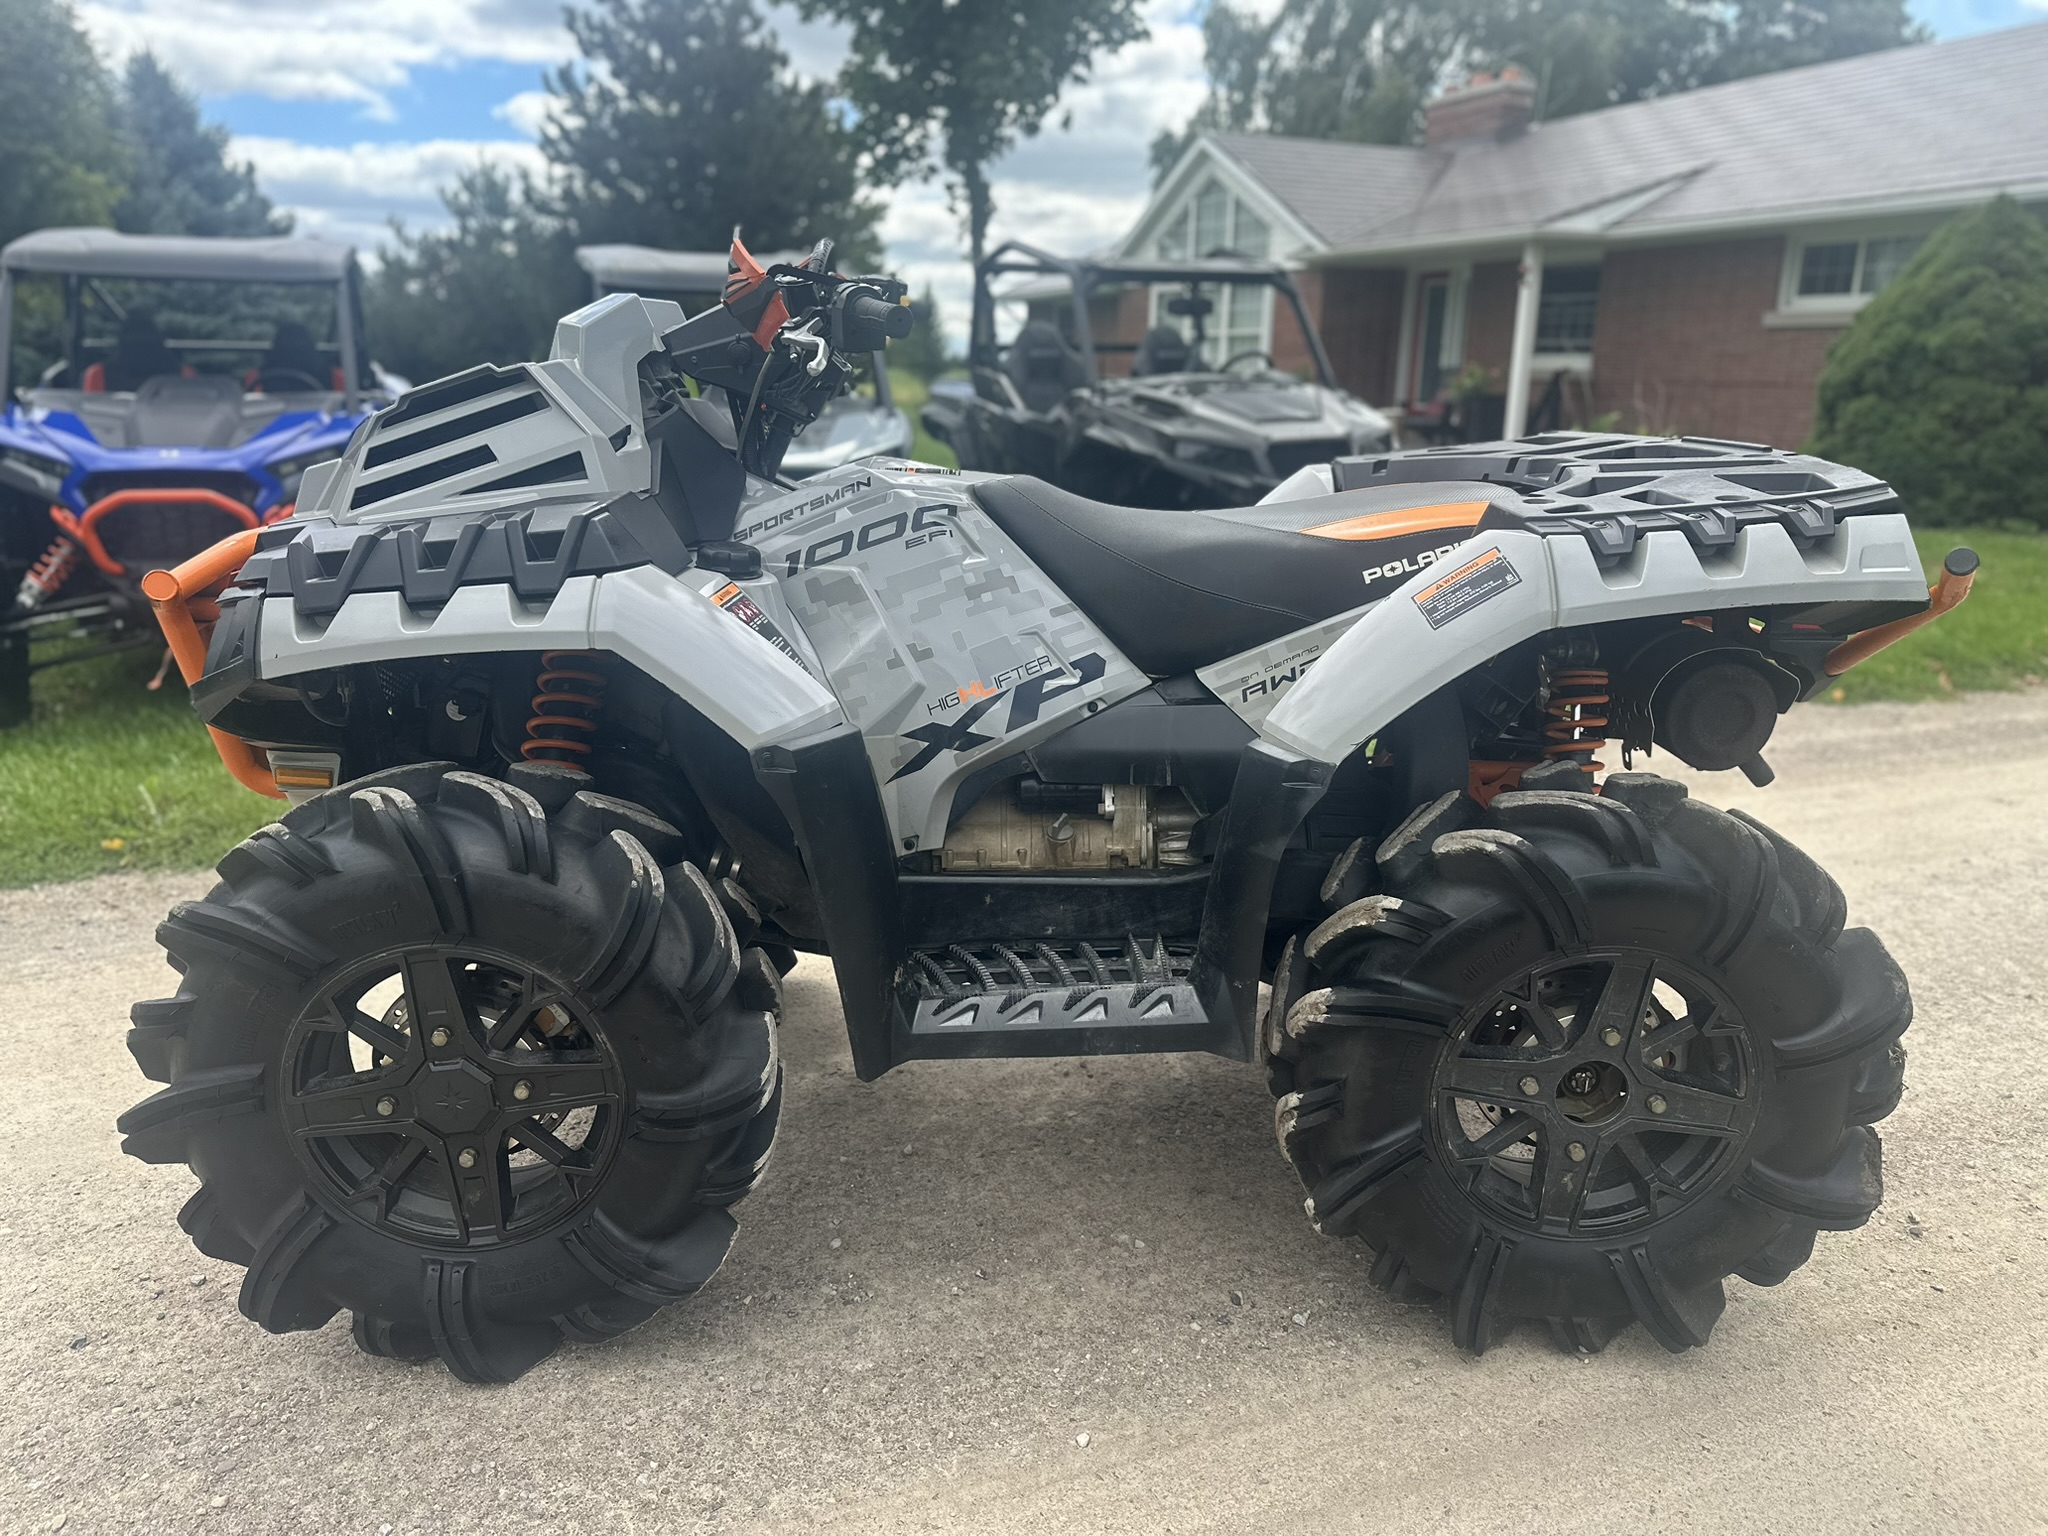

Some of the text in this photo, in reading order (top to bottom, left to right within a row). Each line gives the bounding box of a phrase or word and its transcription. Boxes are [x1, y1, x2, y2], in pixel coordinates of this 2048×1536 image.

[733, 476, 872, 543] SPORTSMAN
[785, 504, 958, 578] 1000
[905, 529, 954, 550] EFI
[1442, 561, 1480, 585] WARNING
[1264, 645, 1319, 673] DEMAND
[884, 652, 1107, 786] XP
